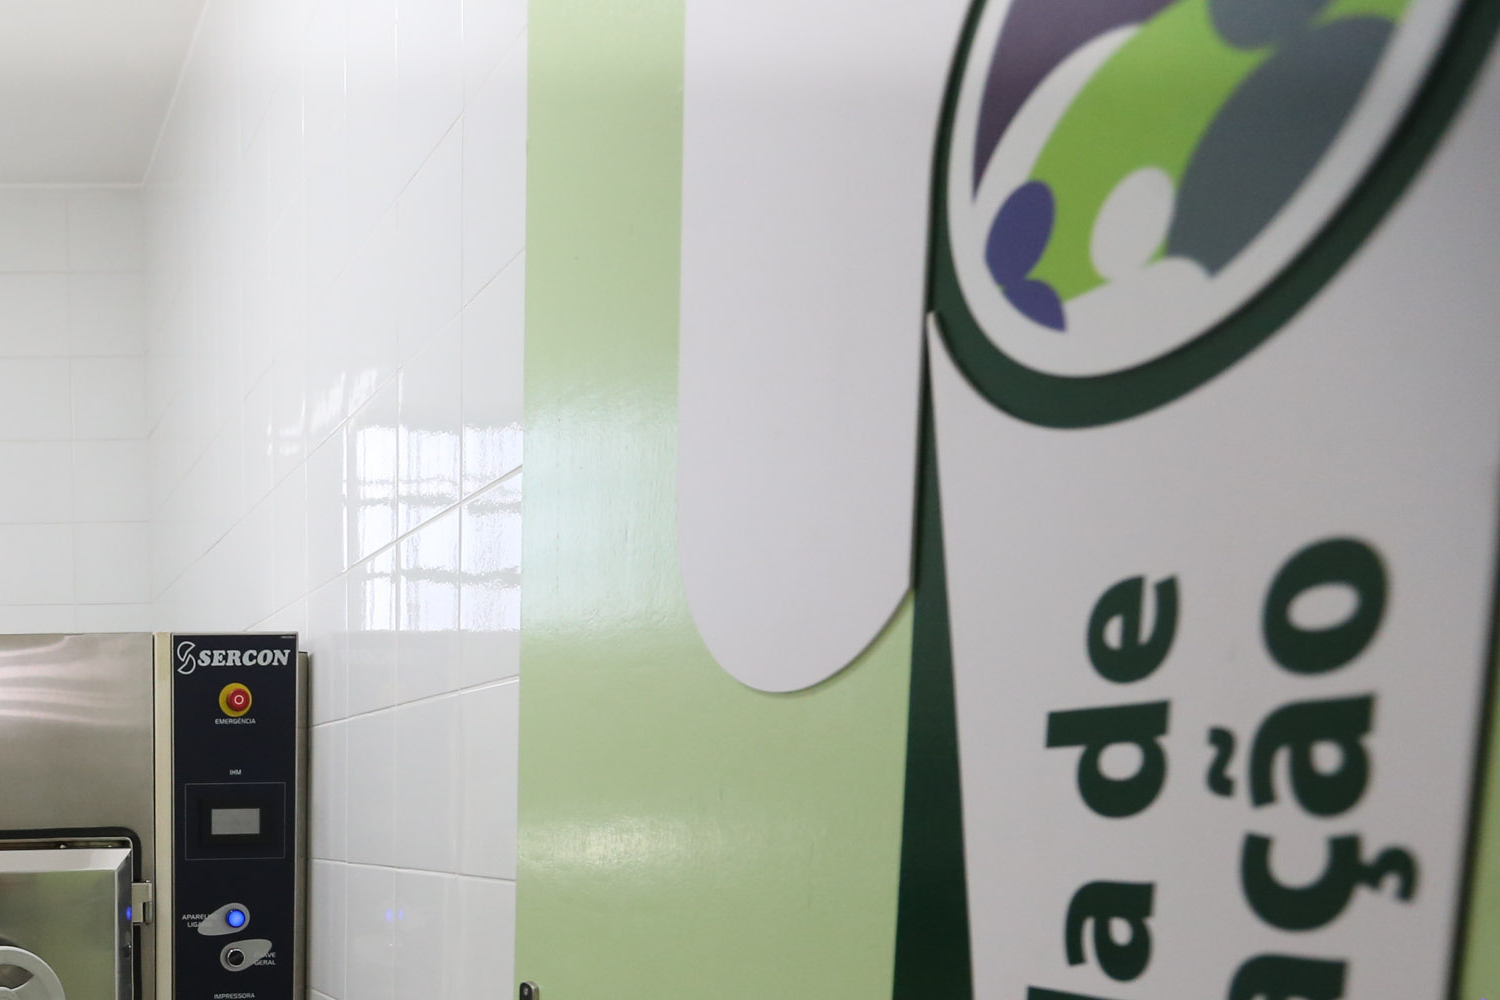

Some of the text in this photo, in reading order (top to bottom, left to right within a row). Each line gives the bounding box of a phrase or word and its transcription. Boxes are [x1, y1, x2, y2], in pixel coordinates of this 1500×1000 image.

[197, 649, 291, 667] SERCON
[1047, 577, 1178, 818] de
[214, 716, 256, 725] EMERGÊNCIA
